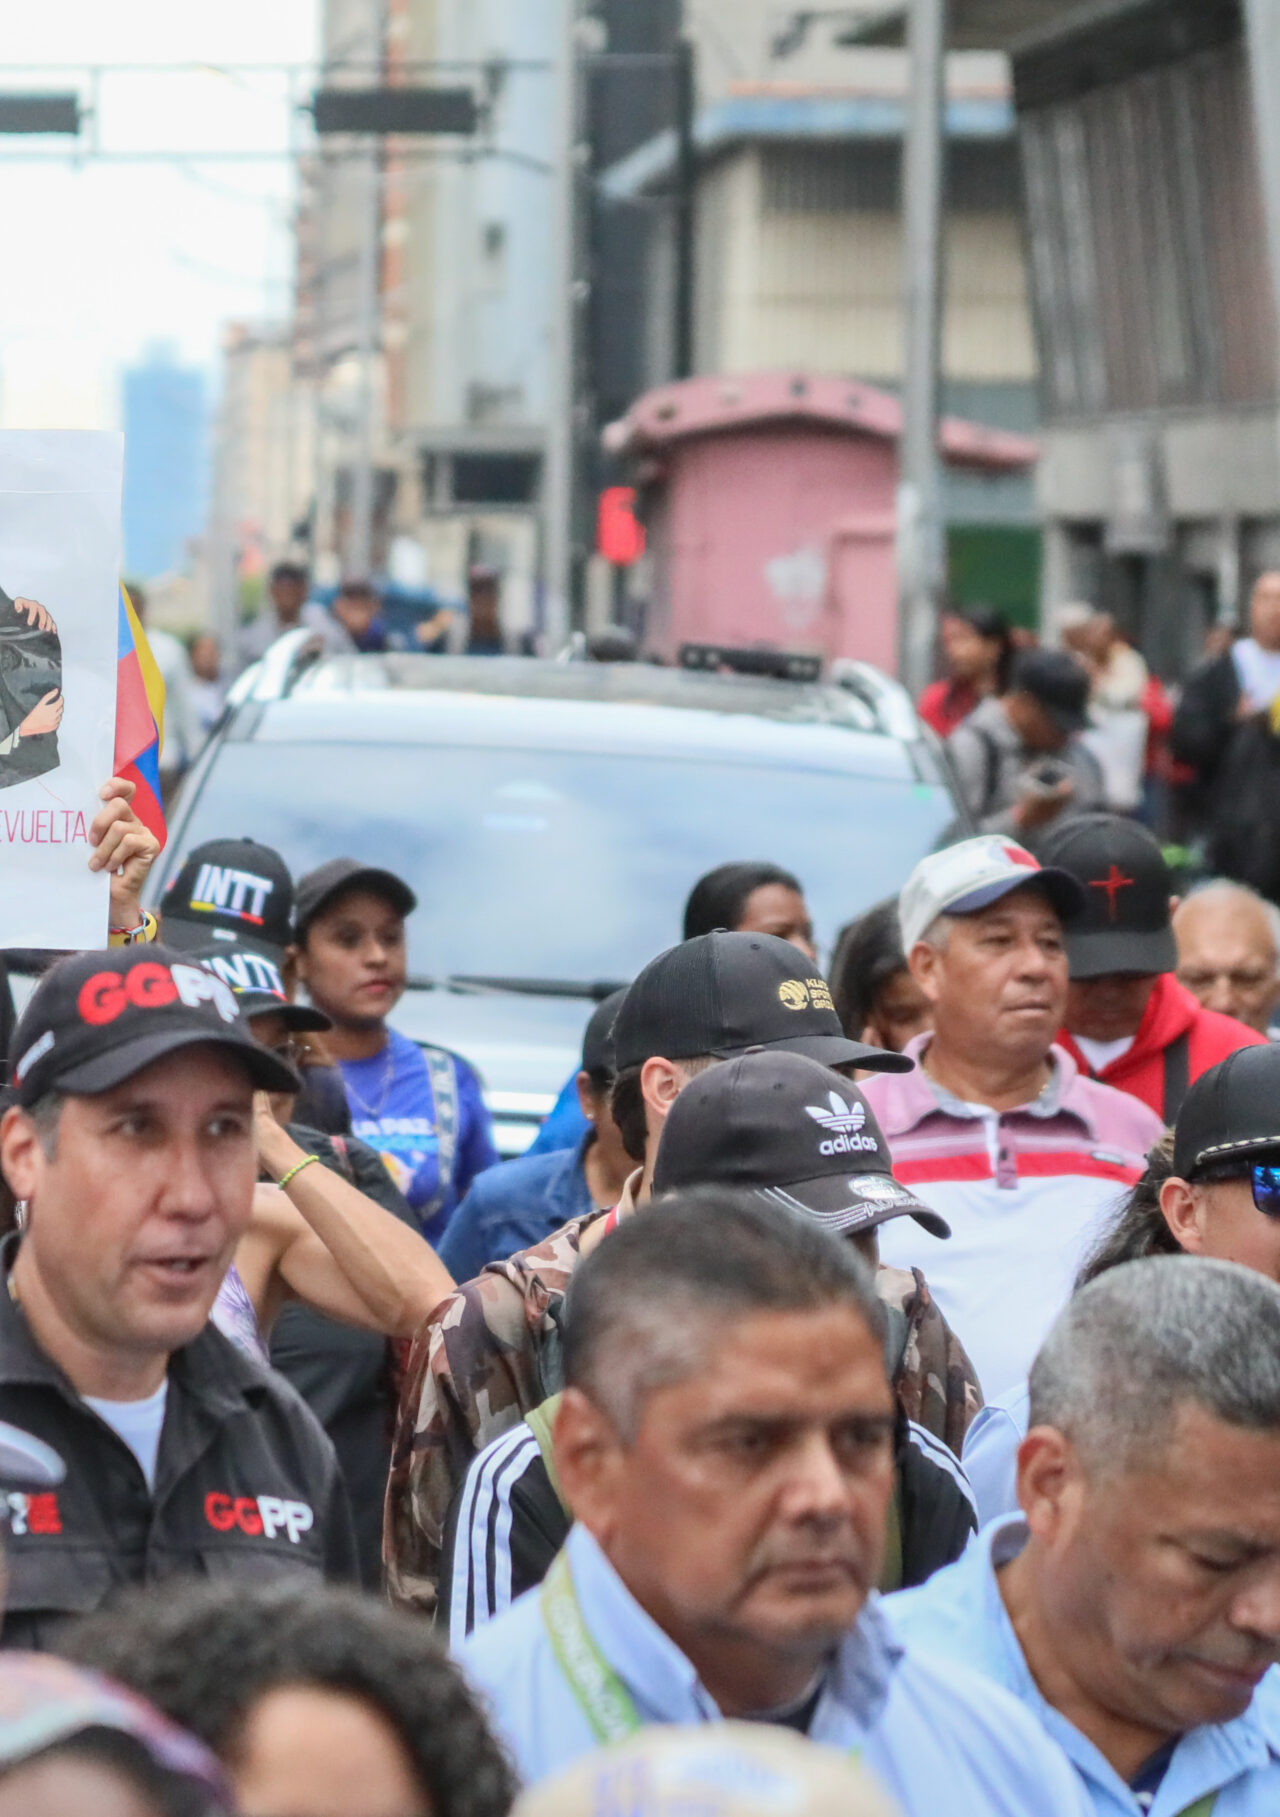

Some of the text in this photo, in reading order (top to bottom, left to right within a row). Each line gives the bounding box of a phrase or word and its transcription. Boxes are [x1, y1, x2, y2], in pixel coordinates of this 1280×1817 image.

[193, 863, 273, 917] INTT
[819, 1132, 878, 1156] adidas
[204, 1491, 314, 1544] GGPP
